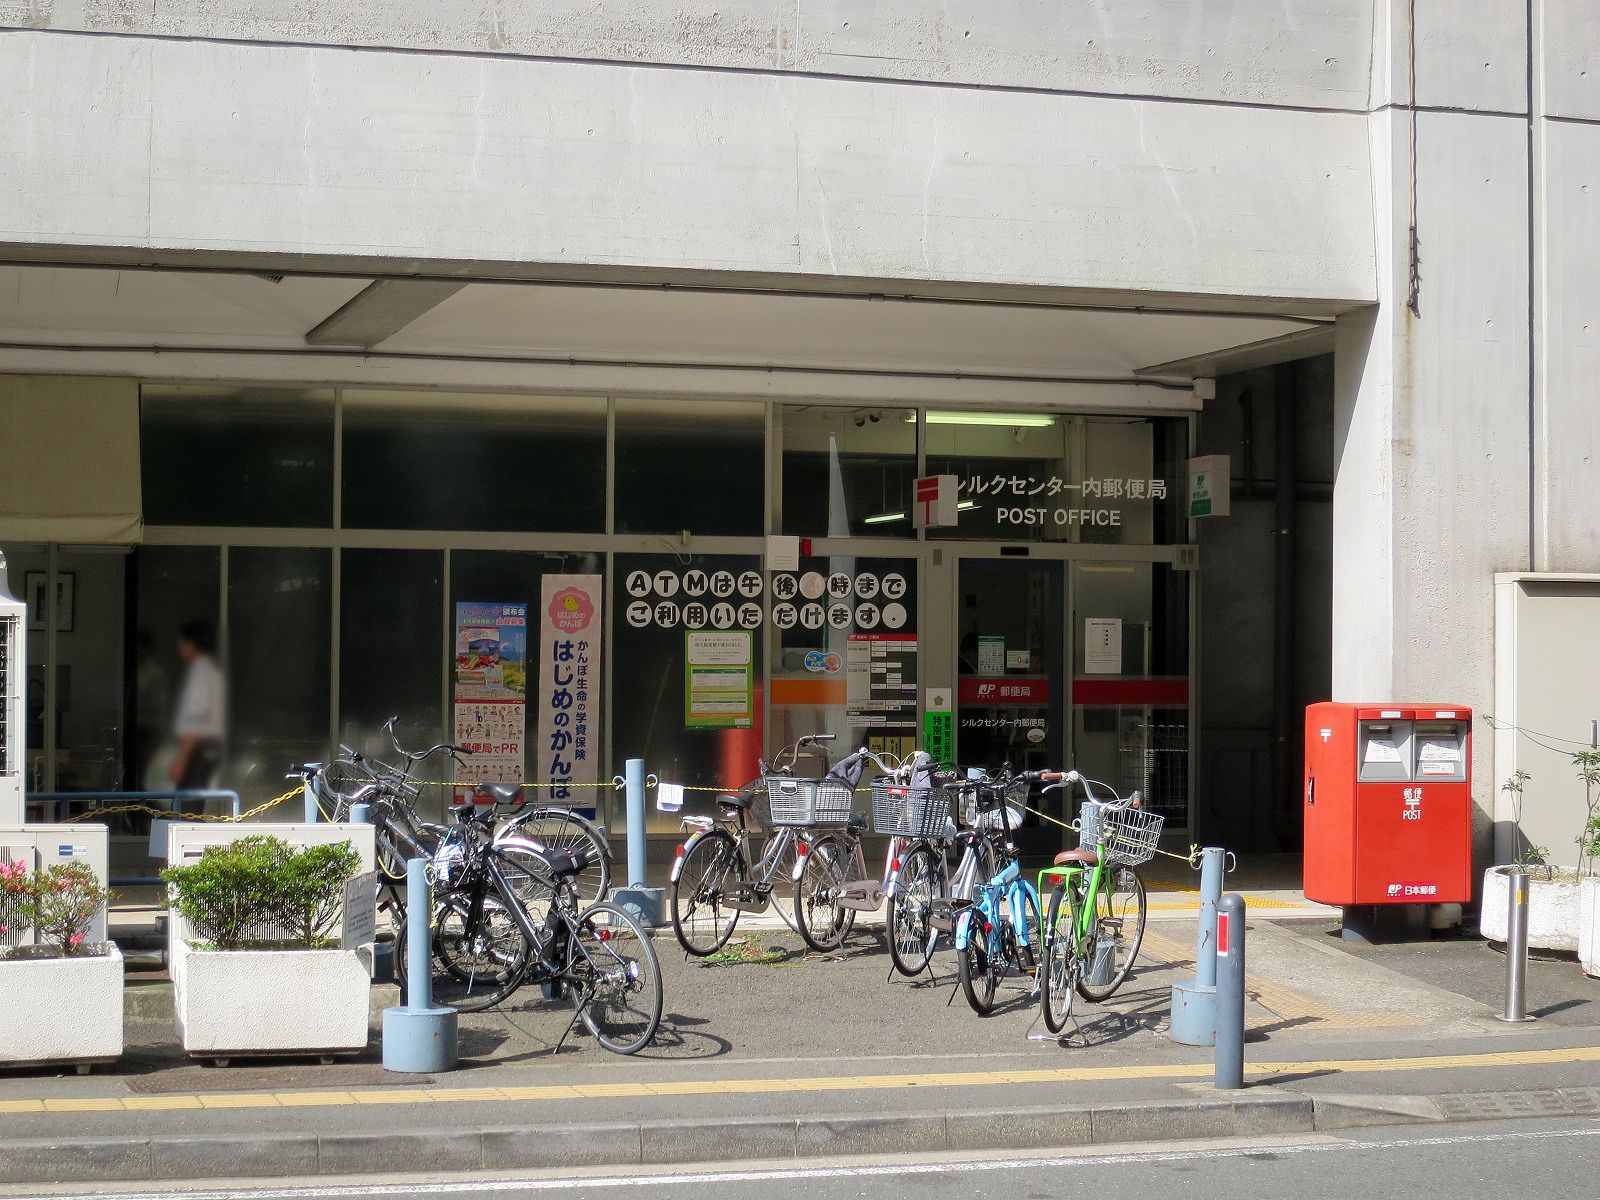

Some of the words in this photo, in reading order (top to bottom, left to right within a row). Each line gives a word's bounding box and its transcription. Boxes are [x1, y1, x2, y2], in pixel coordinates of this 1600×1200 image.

[997, 507, 1047, 526] POST
[1053, 507, 1121, 526] OFFICE
[627, 572, 905, 597] ATMは午後時まで
[1000, 686, 1031, 697] 郵便局
[574, 640, 589, 761] かんぽ生命の学資保険
[549, 640, 575, 800] はじめのかんぽ
[961, 718, 1046, 728] シルクセンター内郵便局
[1403, 787, 1422, 800] 郵便
[1403, 809, 1422, 820] POST
[1404, 885, 1438, 895] 日本郵便
